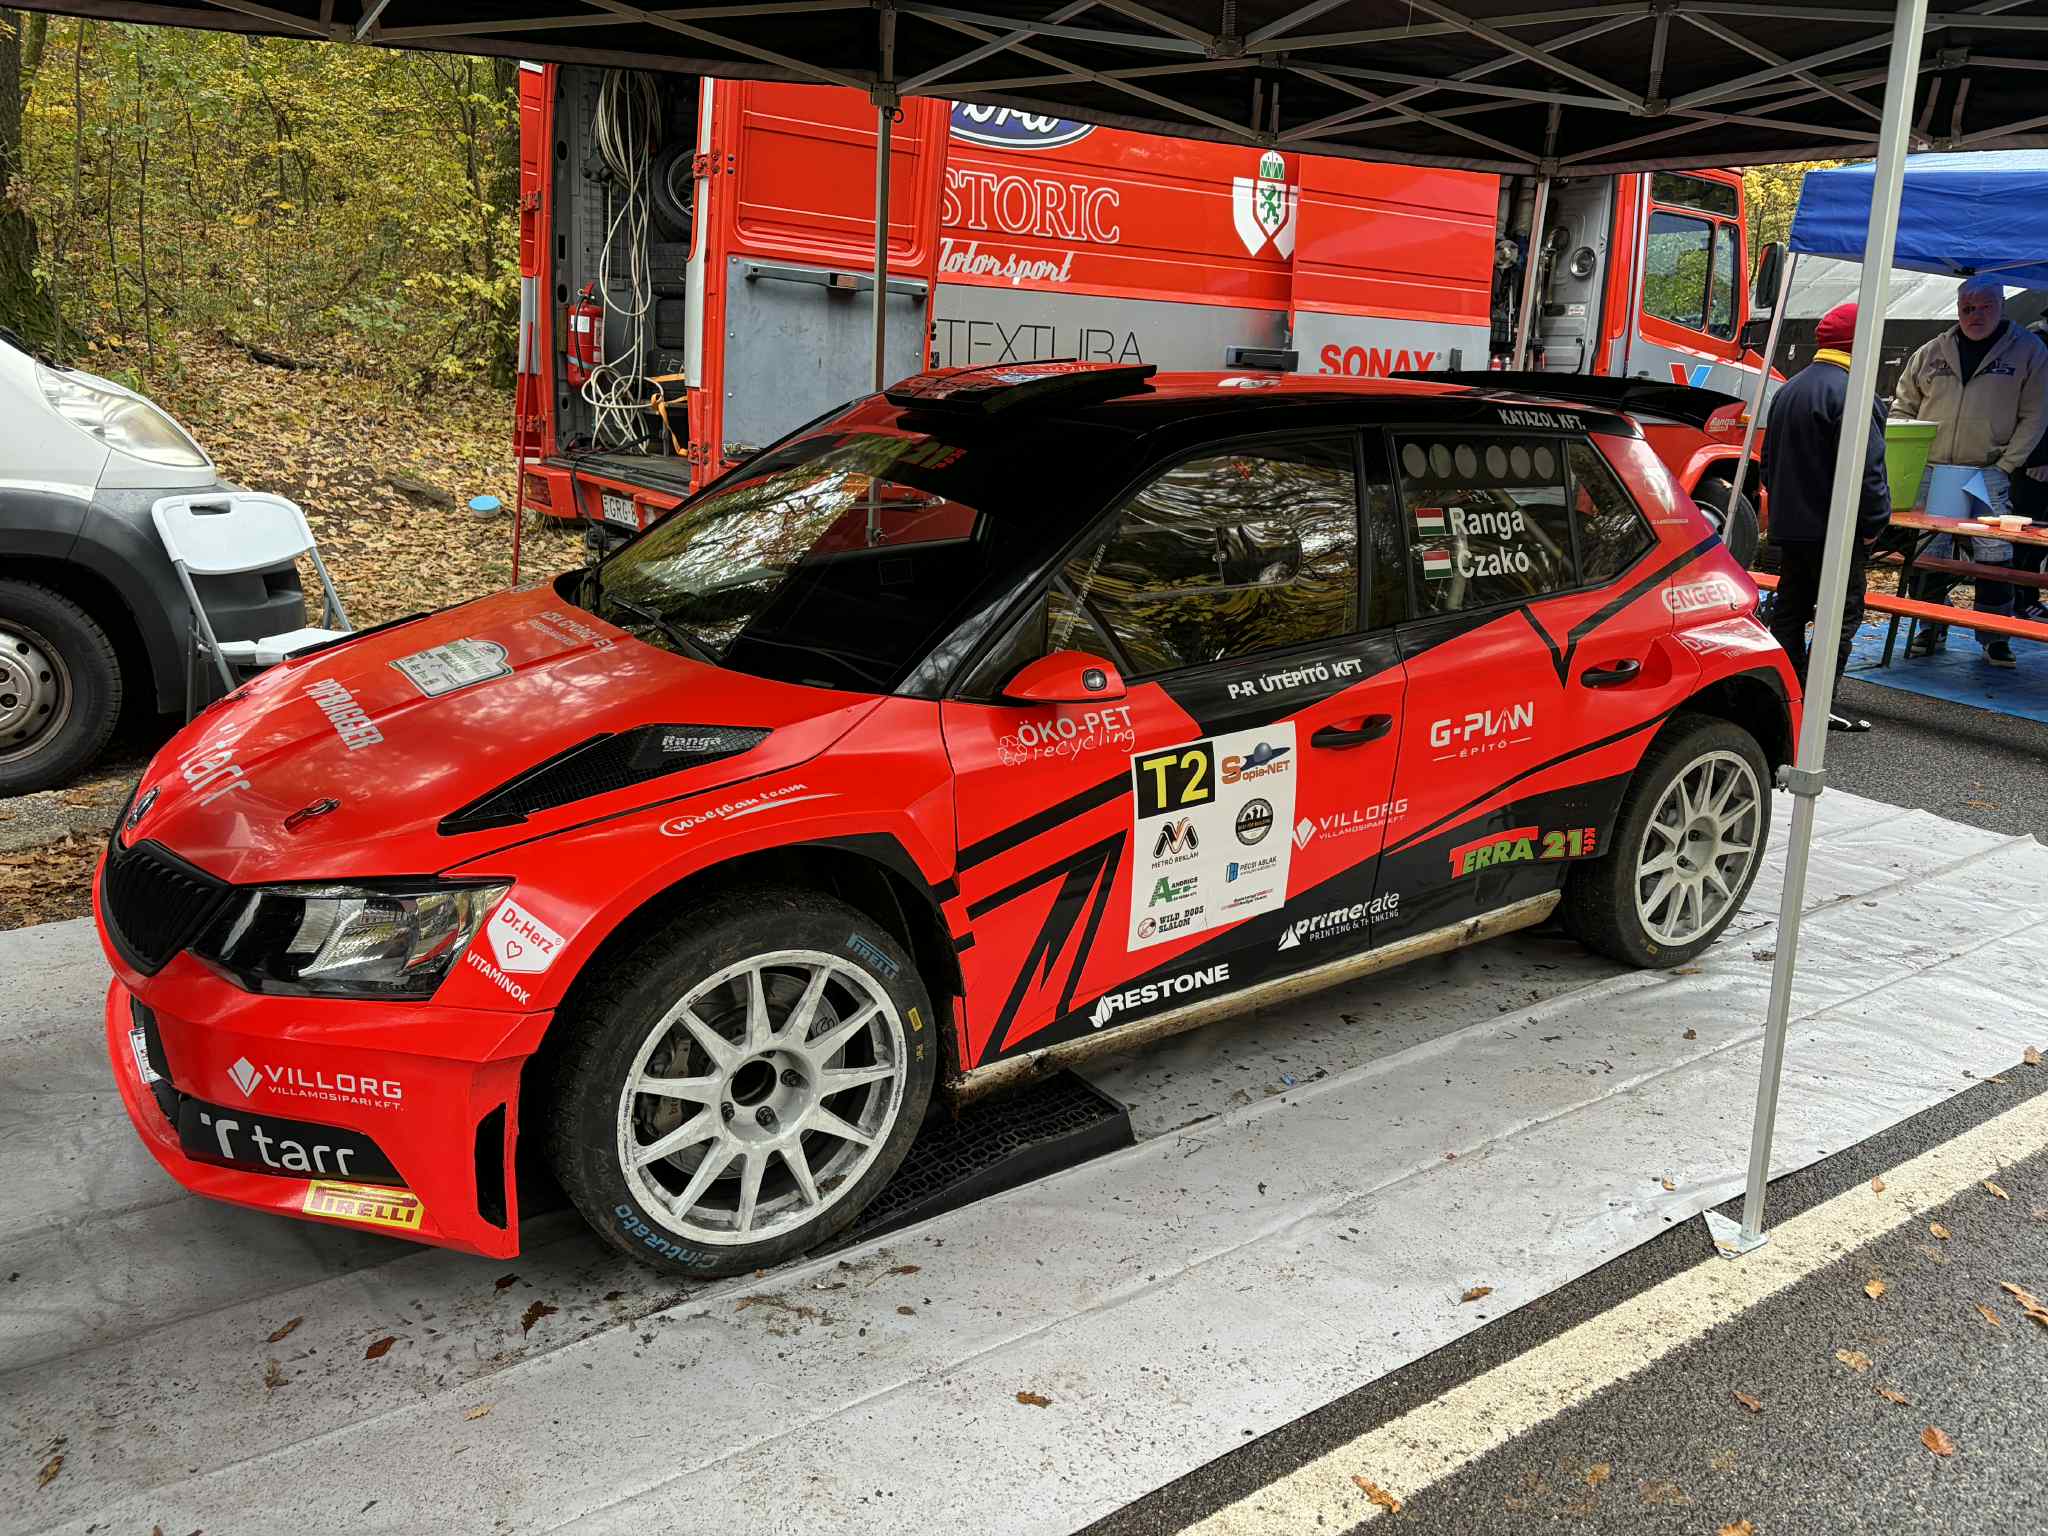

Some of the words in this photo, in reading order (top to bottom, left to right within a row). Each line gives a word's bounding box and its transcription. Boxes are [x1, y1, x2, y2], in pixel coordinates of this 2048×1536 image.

[1497, 408, 1558, 429] KATAZOL
[1557, 413, 1587, 430] KFT.
[1448, 507, 1526, 541] Ranga
[1457, 543, 1530, 578] Czakó
[1227, 680, 1259, 700] P-R
[1259, 662, 1329, 692] ÚTÉPÍTŐ
[1331, 658, 1363, 678] KFT
[661, 735, 722, 750] Ranga
[1018, 705, 1131, 746] ÖKO-PET
[1034, 727, 1136, 761] recycling
[1142, 750, 1209, 809] T2
[1319, 799, 1409, 831] VILLORG
[1448, 826, 1540, 881] TERRA
[1539, 828, 1584, 860] 21
[1158, 917, 1191, 934] SLALOM
[1159, 912, 1180, 924] WILD
[1295, 890, 1400, 935] primerate
[500, 907, 555, 955] Dr.Herz
[1309, 920, 1351, 942] PRINTING
[466, 950, 531, 1006] VITAMINOK
[264, 1065, 403, 1100] VILLORG
[250, 1125, 355, 1177] tarr
[310, 1186, 419, 1223] PIRELLI
